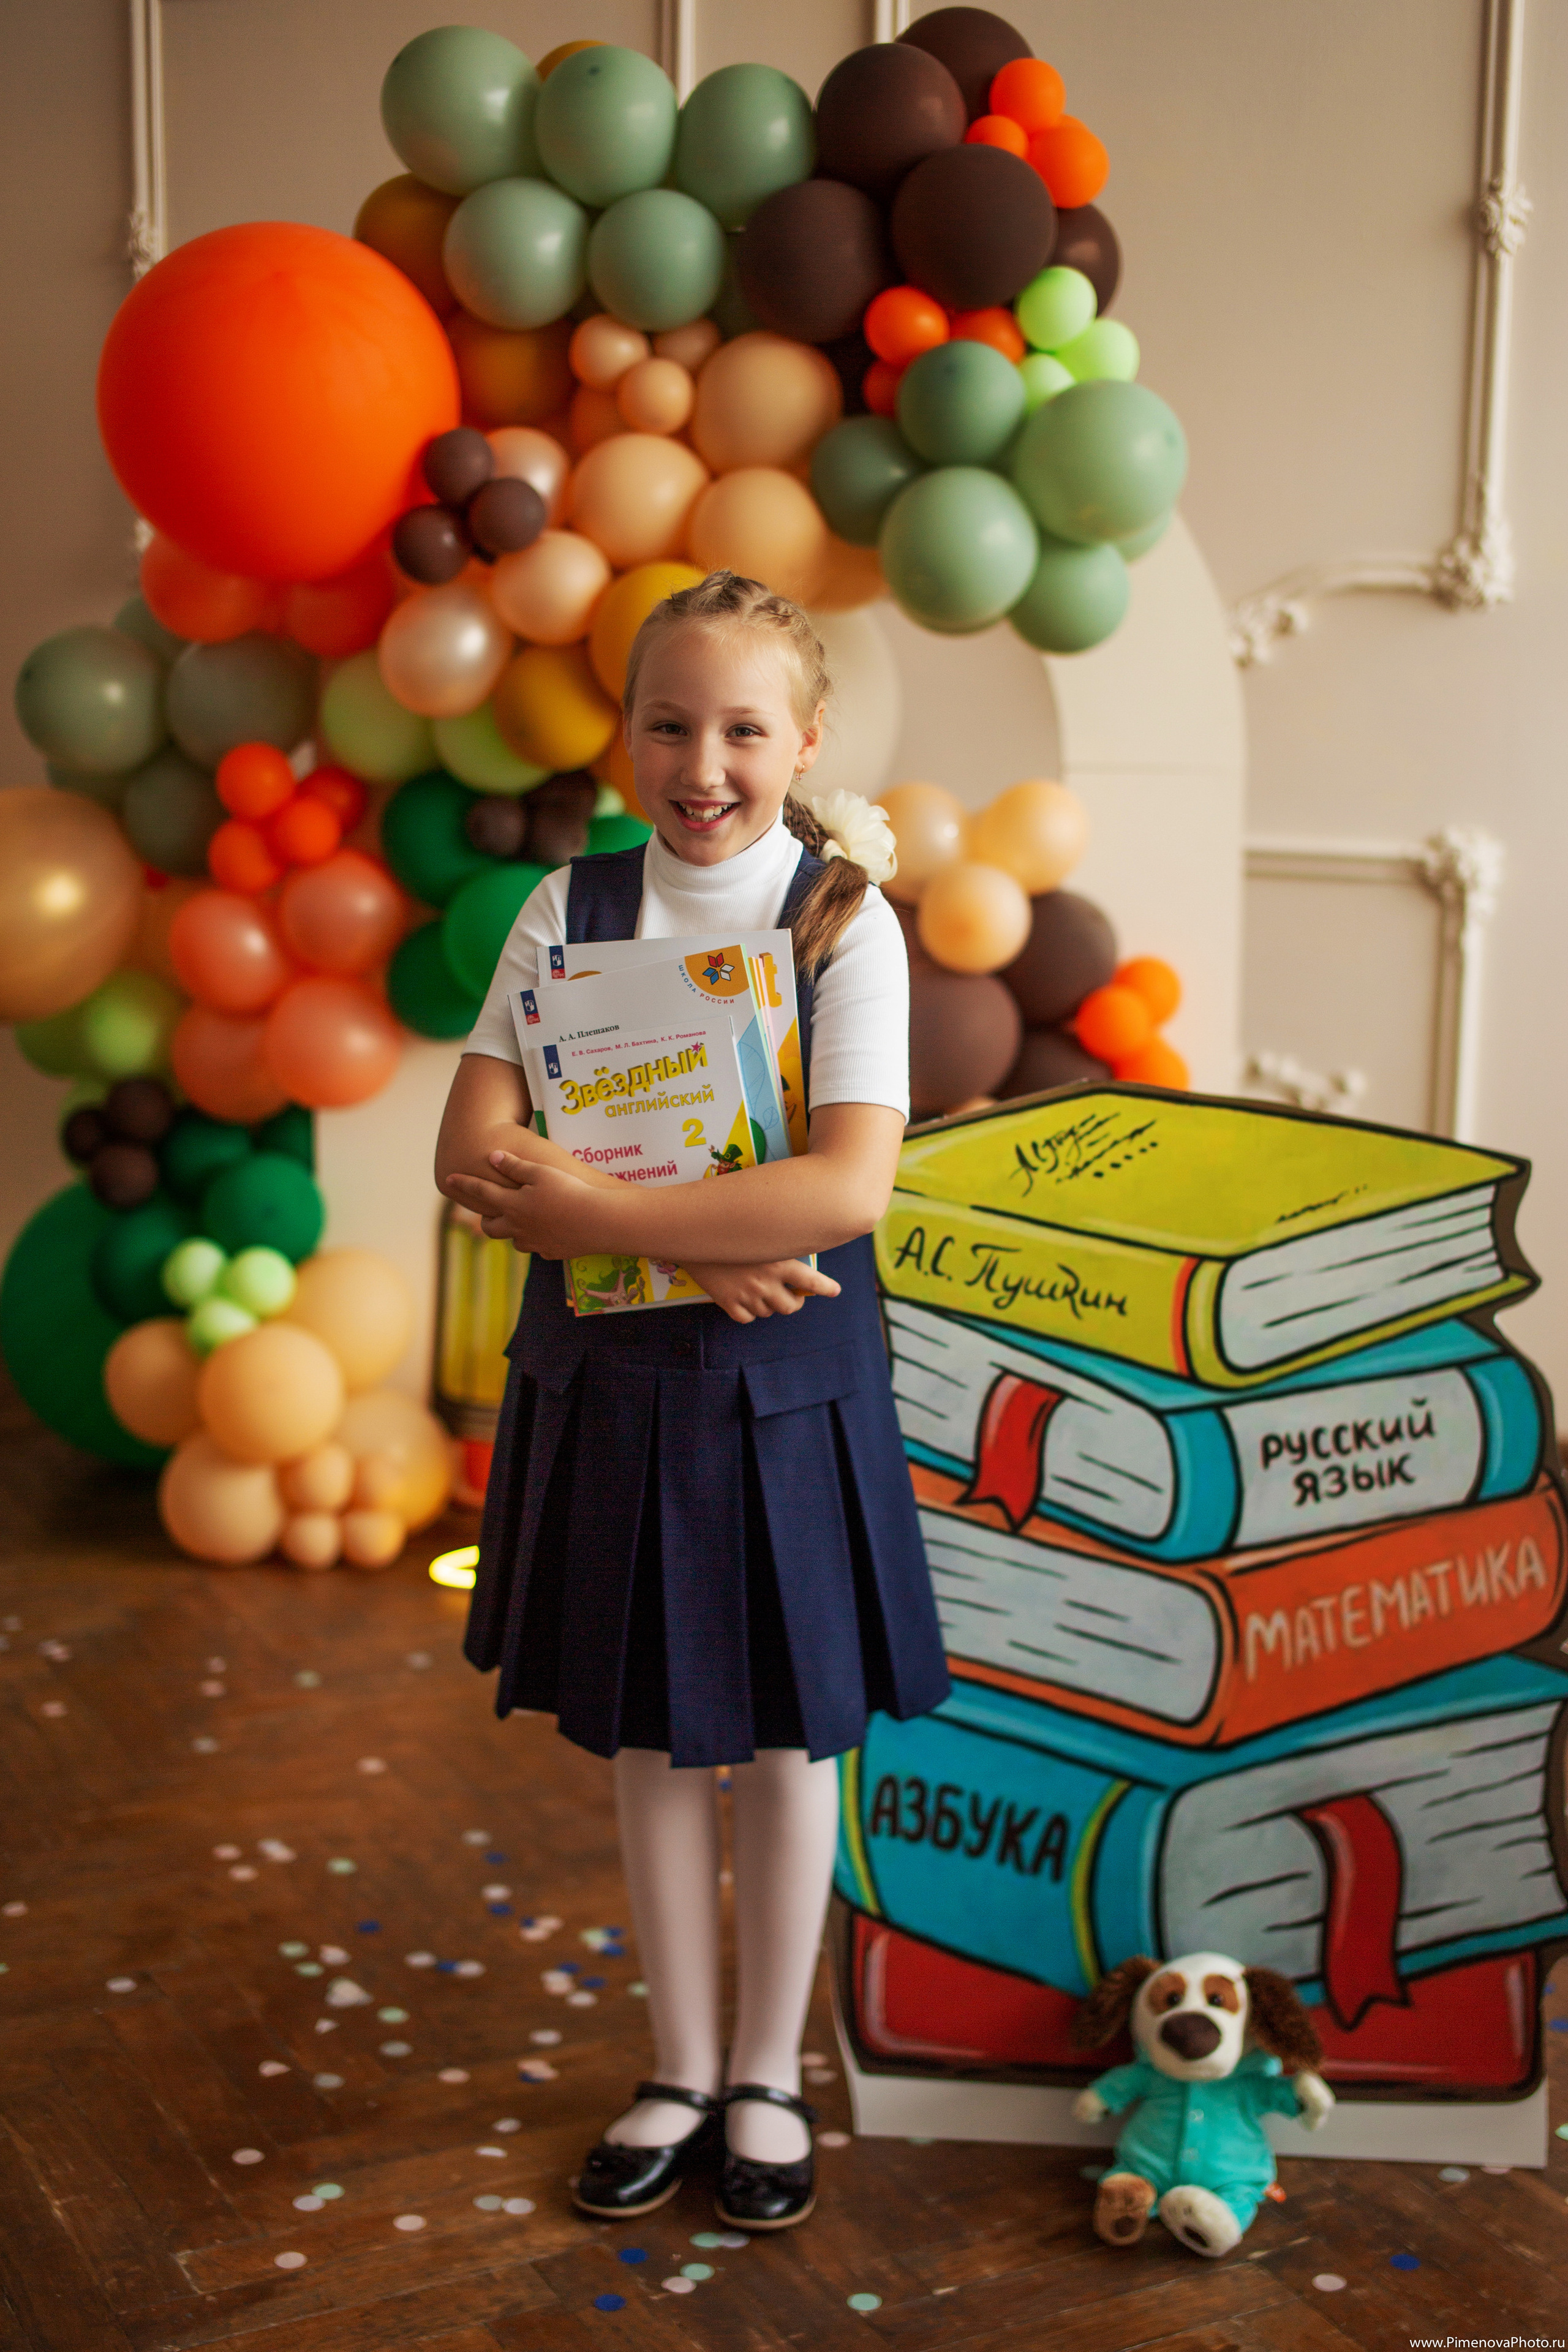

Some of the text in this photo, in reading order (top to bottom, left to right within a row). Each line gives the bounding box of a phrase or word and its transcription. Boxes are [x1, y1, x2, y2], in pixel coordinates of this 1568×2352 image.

[678, 965, 734, 1004] ШКОЛА РОССИИ
[577, 1025, 620, 1038] Плешаков
[631, 1038, 659, 1047] Бахтина,
[676, 1030, 706, 1039] Романова
[559, 1042, 708, 1115] Звёздный
[605, 1084, 715, 1117] английский
[682, 1118, 707, 1148] 2
[572, 1144, 644, 1164] Сборник
[608, 1160, 678, 1182] жнений
[965, 1243, 1128, 1320] Пушкин
[1293, 1453, 1416, 1506] ЯЗЫК
[1244, 1535, 1548, 1683] МАТЕМАТИКА
[870, 1773, 1071, 1884] АЗБУКА
